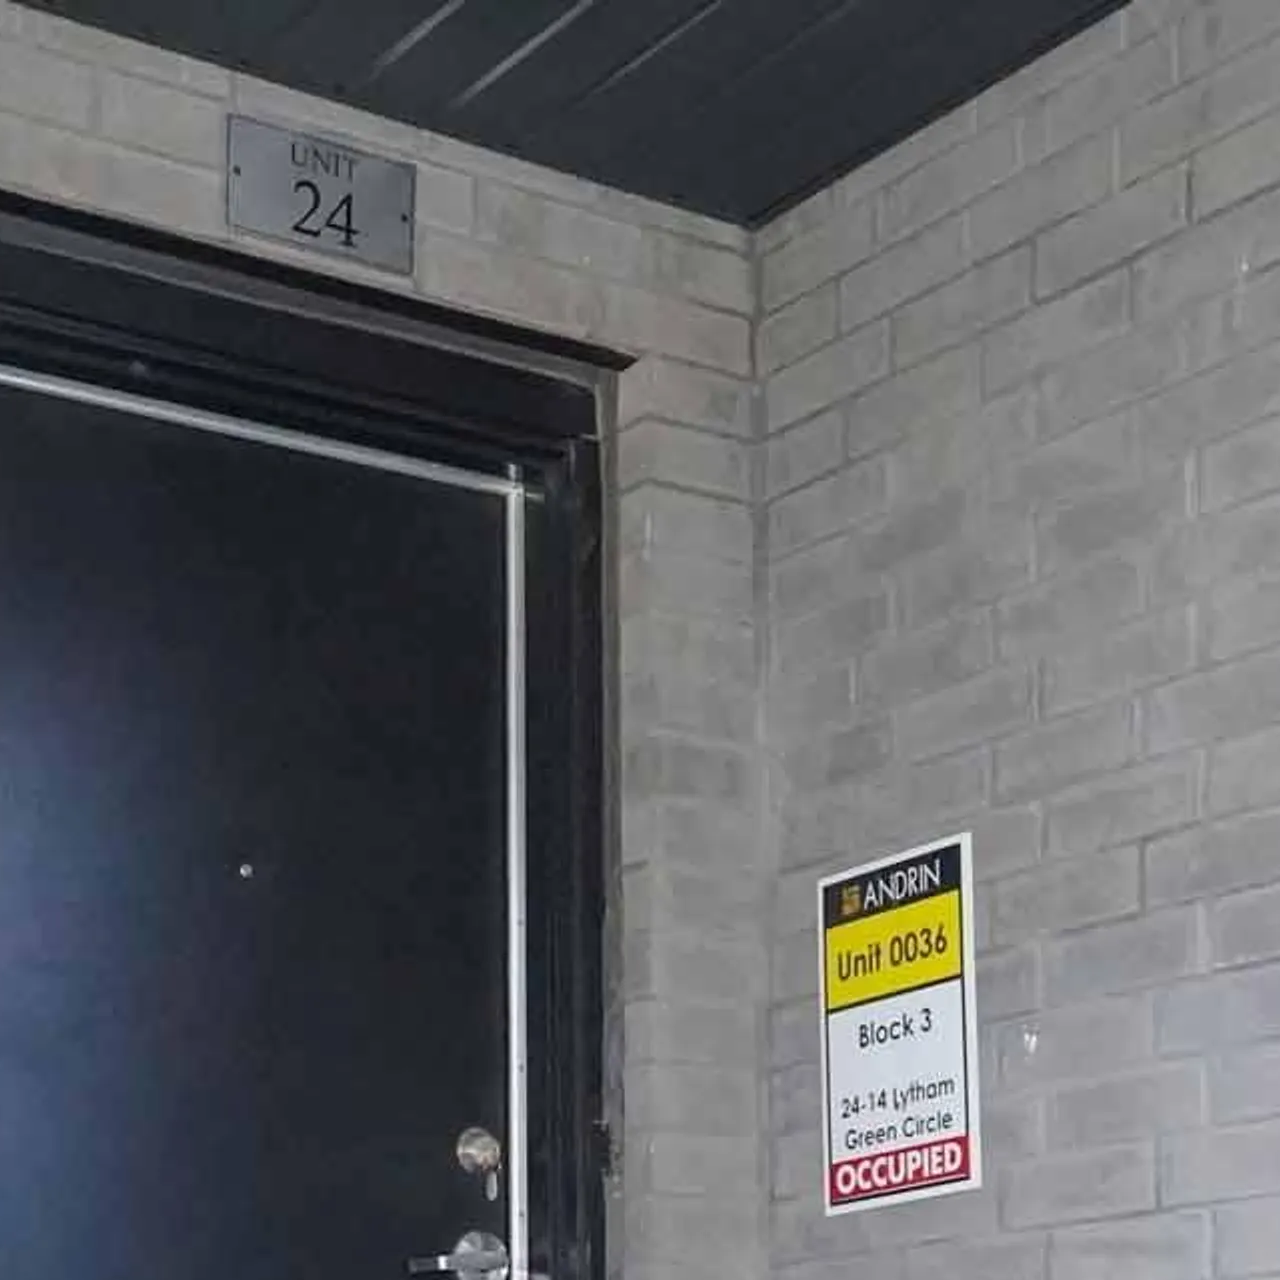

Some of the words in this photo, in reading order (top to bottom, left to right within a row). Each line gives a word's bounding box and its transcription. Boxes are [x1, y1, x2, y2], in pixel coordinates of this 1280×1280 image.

[291, 143, 359, 183] UNIT
[292, 180, 360, 249] 24
[863, 858, 941, 912] ANDRIN
[837, 941, 882, 981] Unit
[889, 923, 948, 967] 0036
[858, 1016, 914, 1049] Block
[919, 1008, 933, 1033] 3
[840, 1089, 888, 1119] 24-14
[893, 1075, 956, 1112] Lytham
[845, 1120, 898, 1151] Green
[903, 1110, 954, 1144] Circle
[836, 1142, 963, 1195] OCCUPIED
